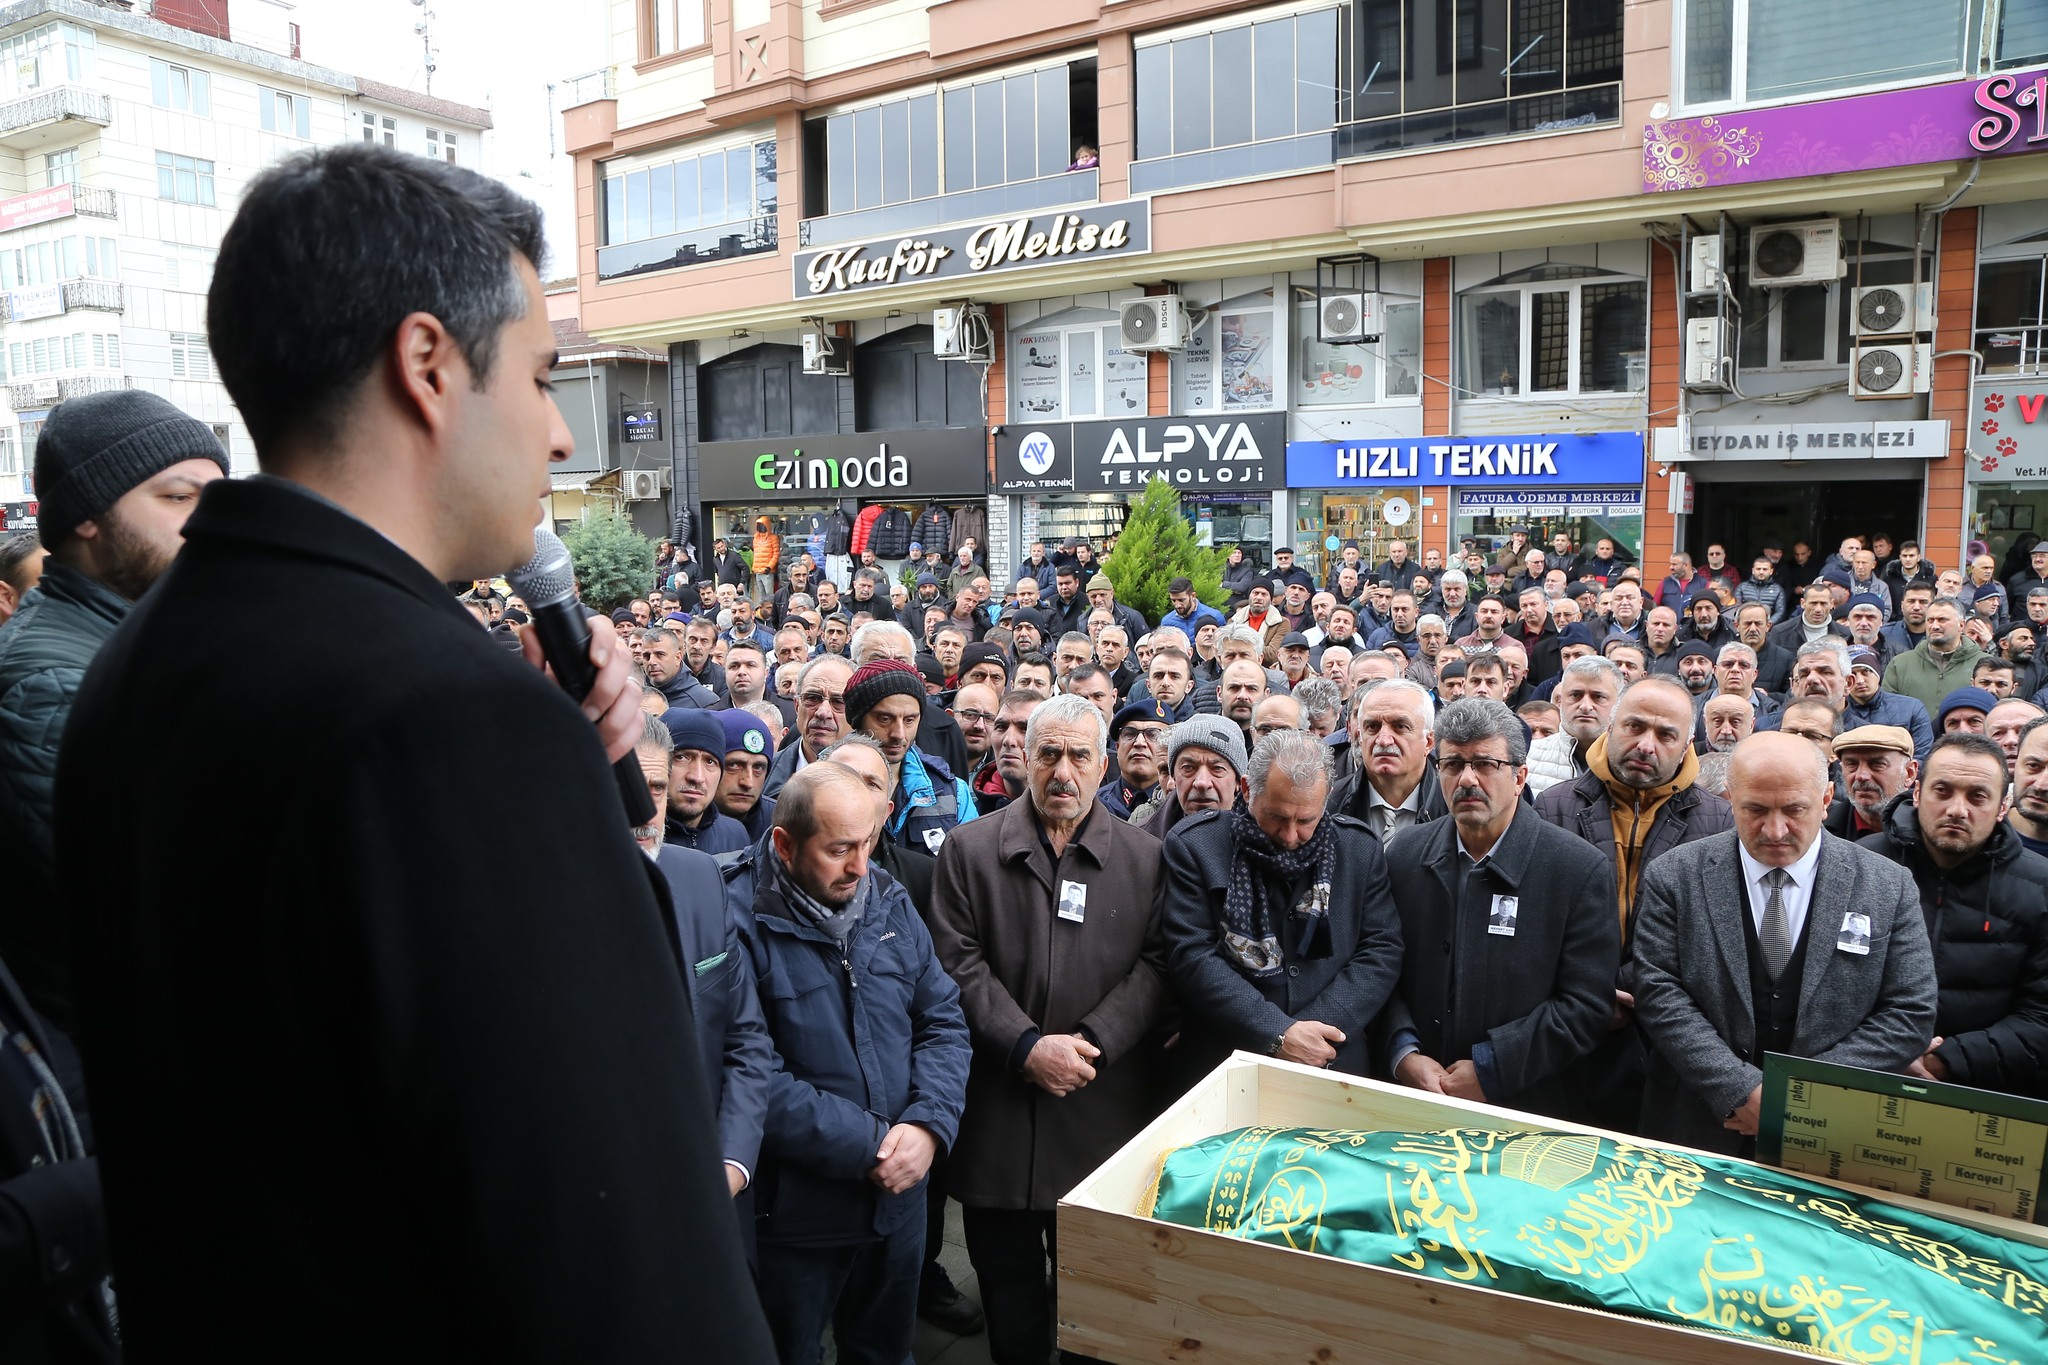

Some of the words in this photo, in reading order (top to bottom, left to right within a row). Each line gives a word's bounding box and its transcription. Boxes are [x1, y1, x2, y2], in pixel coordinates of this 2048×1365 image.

[806, 238, 952, 293] Kuaför
[965, 214, 1128, 271] Melisa
[1019, 335, 1059, 345] HIKVISION
[2016, 394, 2048, 424] V
[1100, 422, 1263, 464] ALPYA
[1692, 434, 1769, 450] EYDAN
[1777, 430, 1799, 453] İŞ
[1807, 428, 1915, 449] MERKEZİ
[1337, 446, 1419, 478] HIZLI
[2015, 467, 2036, 477] Vet.
[2039, 466, 2048, 476] H
[1002, 480, 1037, 489] ALPYA
[1462, 494, 1514, 503] FATURA
[1517, 491, 1567, 503] ÖDEME
[1571, 491, 1636, 502] MERKEZİ
[1784, 1135, 1817, 1149] arayel
[1876, 1128, 1922, 1146] Karayel
[1862, 1148, 1908, 1166] Karayel
[1974, 1147, 2024, 1166] Karayel
[1955, 1166, 2004, 1185] Karayel
[2012, 1188, 2034, 1220] Karayel
